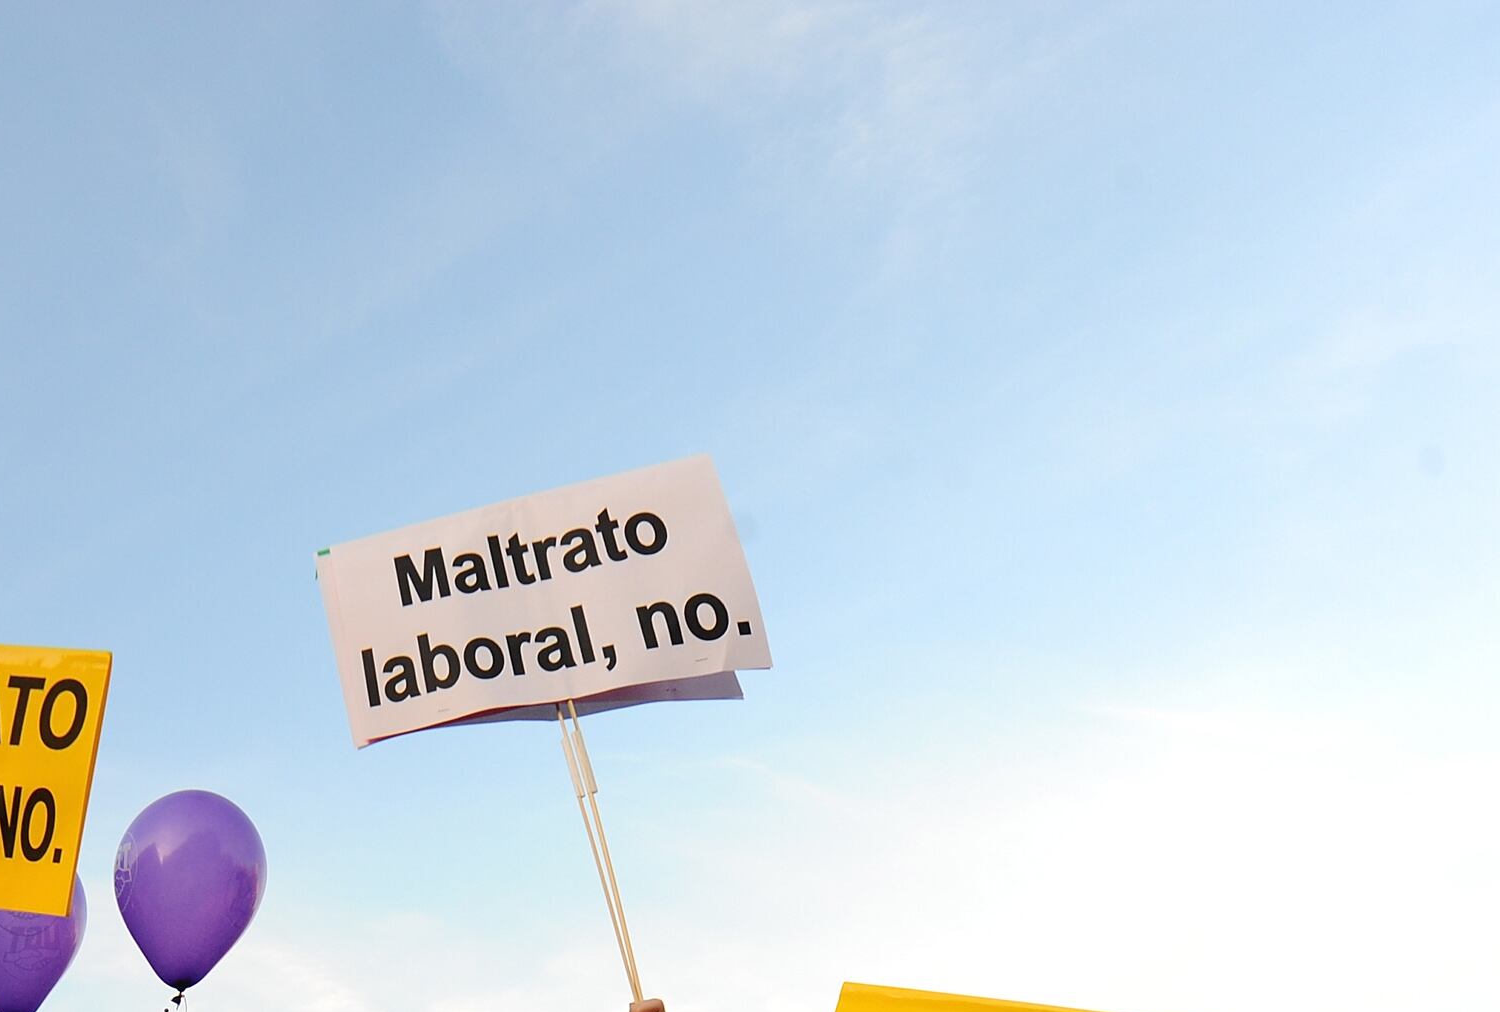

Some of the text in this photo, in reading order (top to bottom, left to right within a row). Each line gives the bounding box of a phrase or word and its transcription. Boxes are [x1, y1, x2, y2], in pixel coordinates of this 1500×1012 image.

[393, 508, 668, 607] Maltrato
[361, 592, 752, 708] laboral, no.
